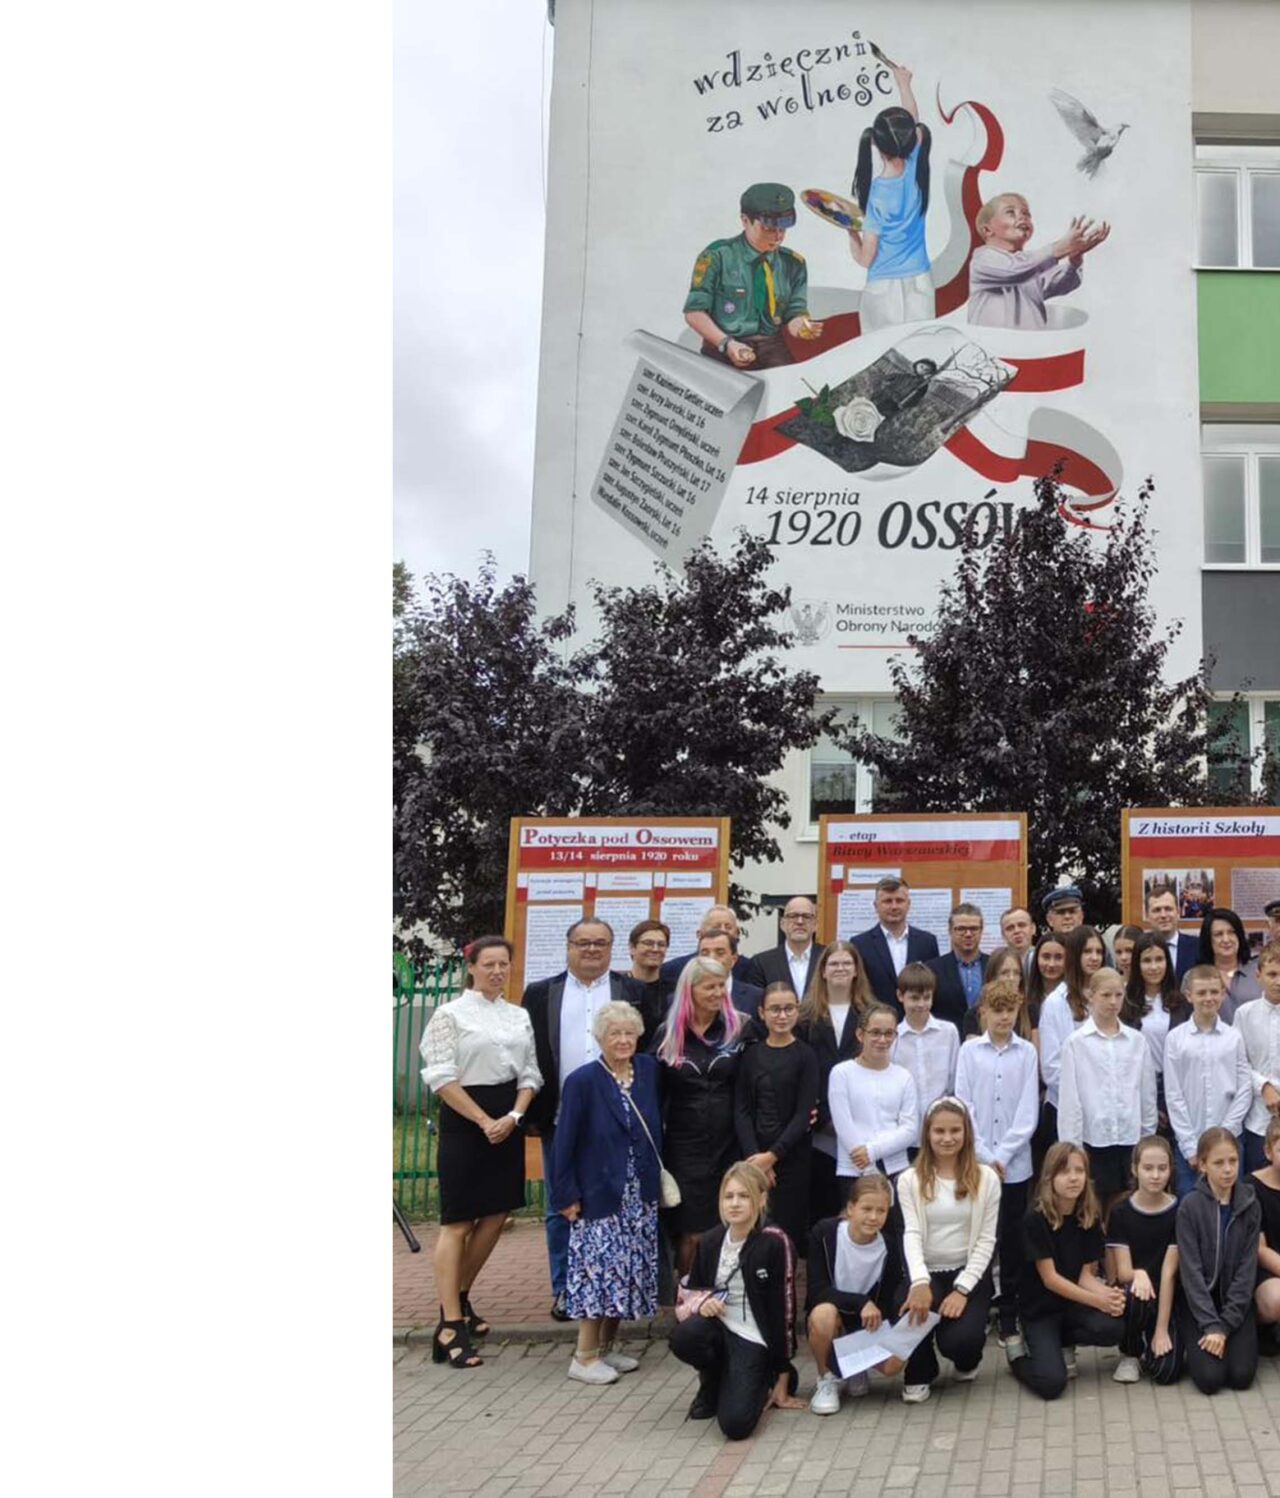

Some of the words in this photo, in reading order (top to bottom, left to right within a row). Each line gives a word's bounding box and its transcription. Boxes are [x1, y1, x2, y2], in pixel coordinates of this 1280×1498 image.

[693, 30, 867, 95] wdzięczni
[706, 111, 743, 133] za
[757, 63, 893, 120] wolność
[695, 416, 706, 429] 16
[620, 464, 631, 478] Jan
[715, 469, 726, 483] 16
[700, 480, 711, 492] 17
[686, 491, 696, 505] 16
[745, 486, 768, 505] 14
[774, 486, 861, 511] sierpnia
[671, 523, 681, 537] 16
[765, 509, 862, 546] 1920
[836, 603, 926, 617] Ministerstwo
[836, 619, 888, 634] Obrony
[891, 619, 941, 633] Narodo
[1138, 822, 1149, 835] Z
[1152, 821, 1210, 835] historii
[1214, 821, 1266, 837] Szkoły
[524, 828, 597, 847] Potyczka
[601, 832, 629, 848] pod
[636, 828, 714, 846] Ossowem
[849, 831, 877, 842] etap
[550, 850, 583, 861] 13/14
[590, 850, 637, 863] sierpnia
[641, 850, 668, 861] 1920
[672, 850, 699, 862] roku
[833, 845, 873, 859] Bitwy
